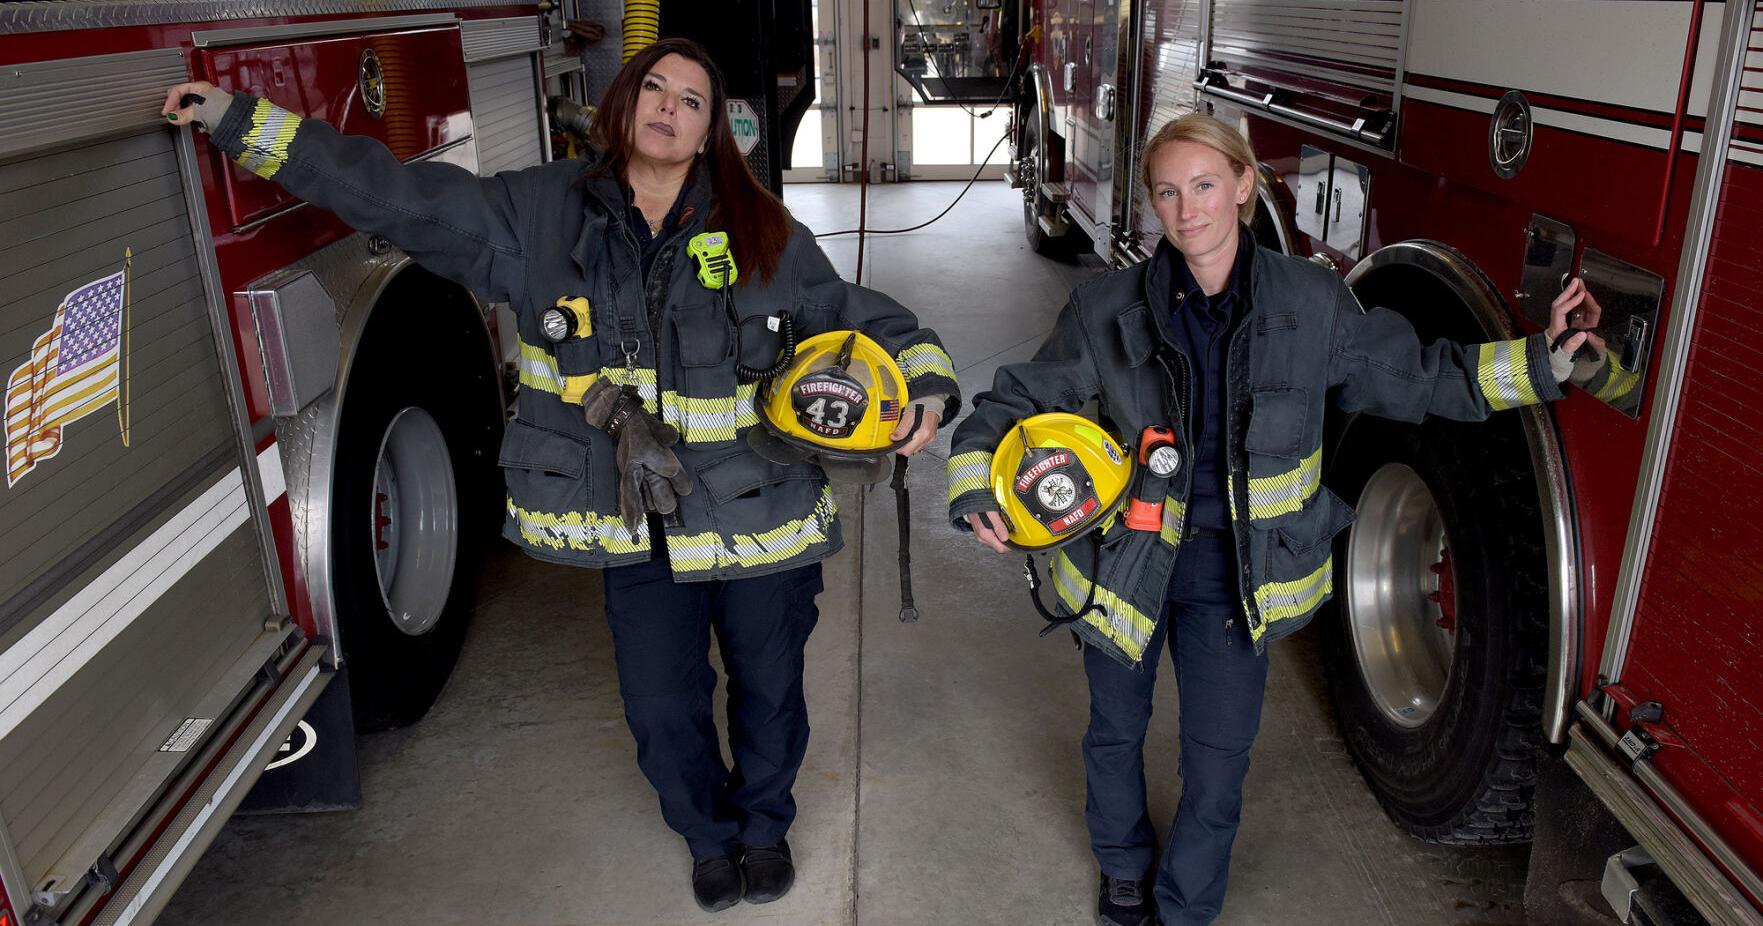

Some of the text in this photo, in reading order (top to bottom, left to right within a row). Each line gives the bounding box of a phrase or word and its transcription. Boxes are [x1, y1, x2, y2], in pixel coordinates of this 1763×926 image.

[731, 118, 756, 137] UTION
[800, 381, 863, 404] FIREFIGHTER
[806, 397, 849, 428] 43
[810, 422, 840, 435] NAFD
[1019, 454, 1066, 488] FIREFIGHTER
[1063, 508, 1085, 526] NAFD
